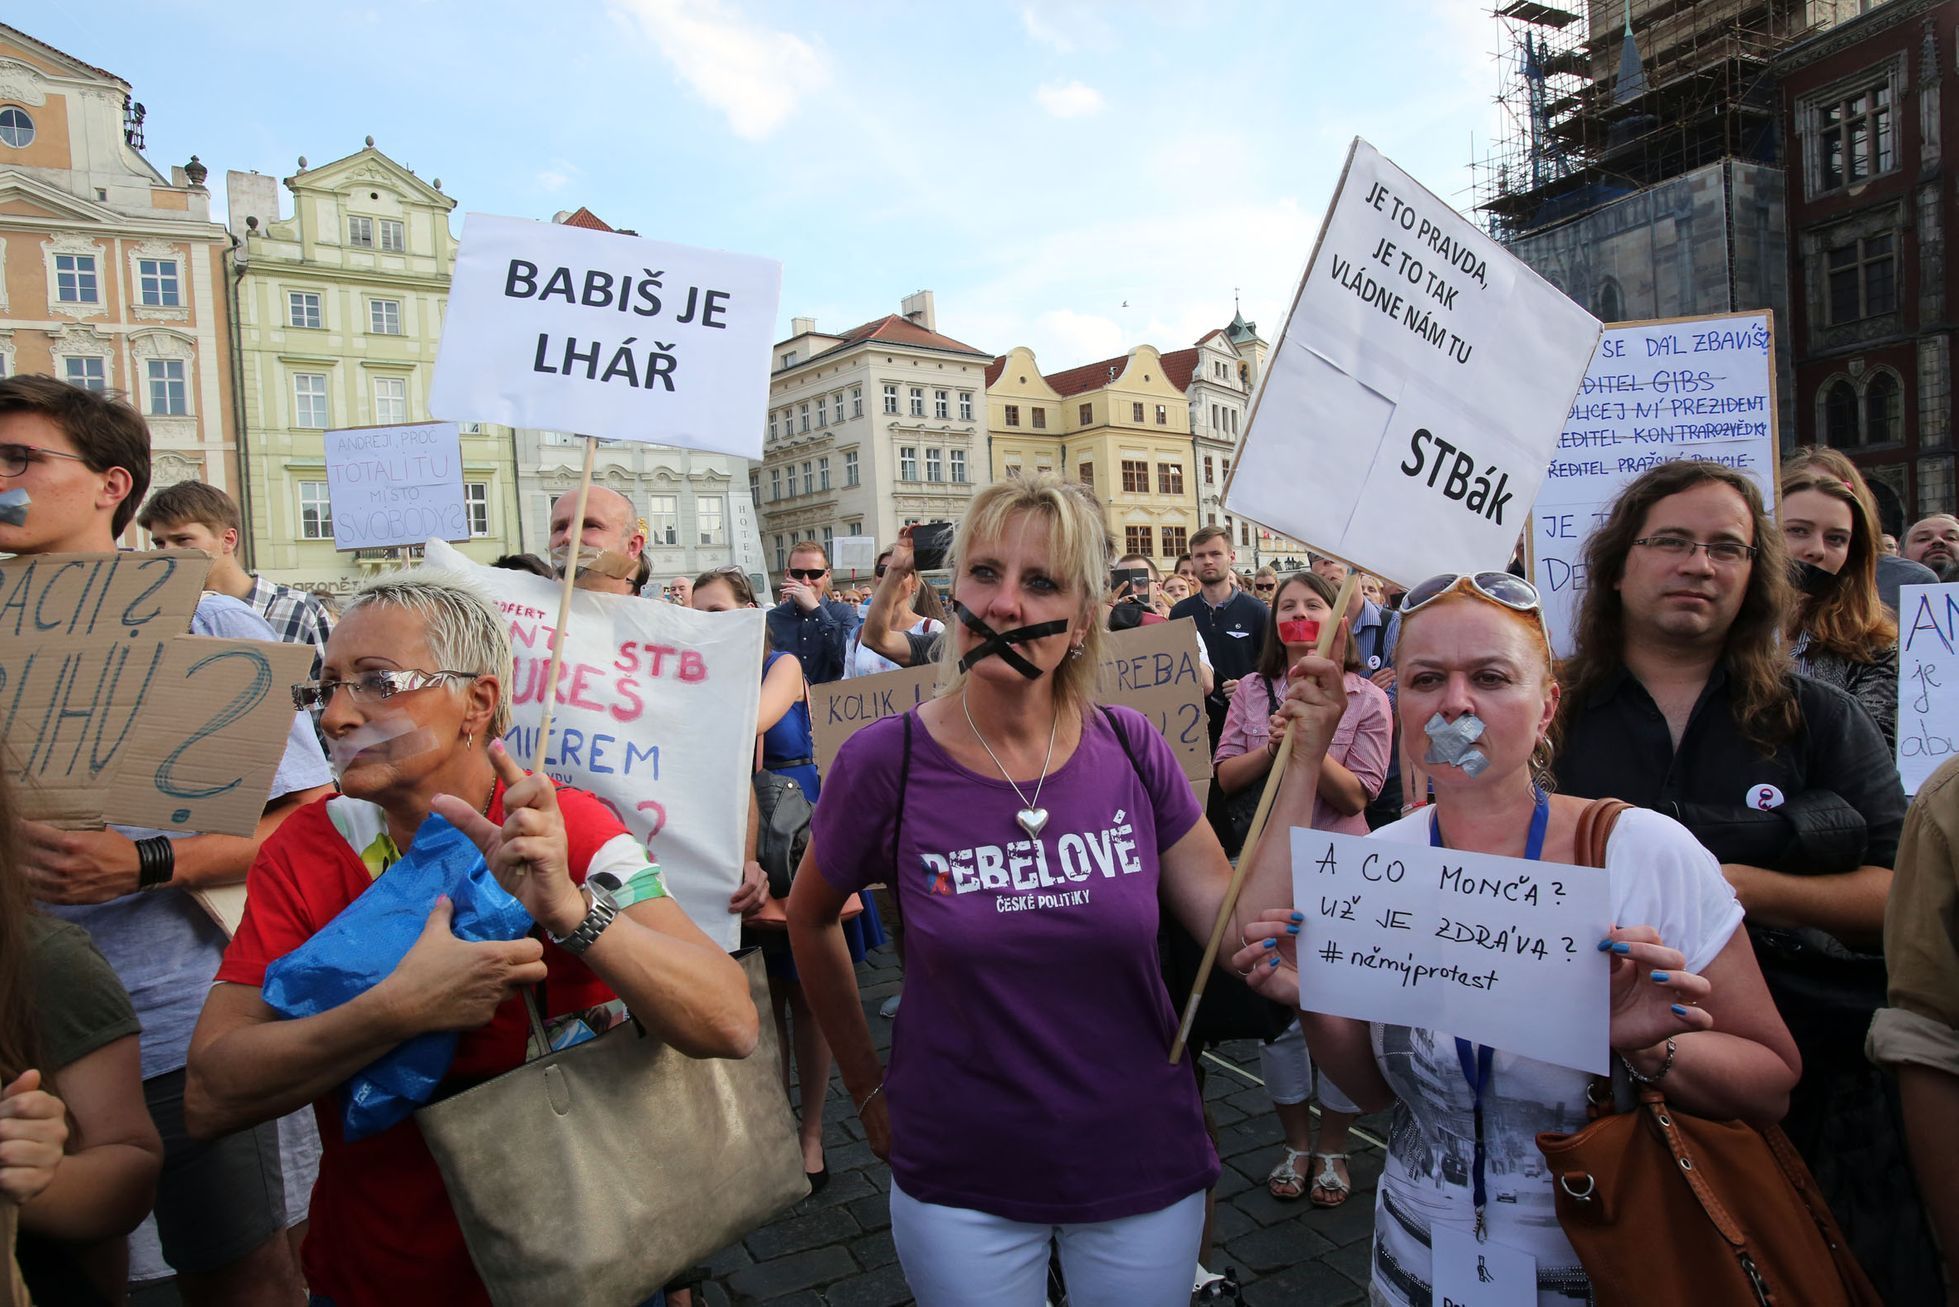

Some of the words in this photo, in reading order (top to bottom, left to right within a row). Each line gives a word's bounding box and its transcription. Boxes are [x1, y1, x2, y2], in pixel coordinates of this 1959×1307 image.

[1365, 181, 1389, 212] JE
[1391, 196, 1416, 231] TO
[1417, 218, 1488, 290] PRAVDA,
[1372, 237, 1397, 267] JE
[1398, 251, 1423, 284] TO
[1426, 270, 1459, 311] TAK
[504, 258, 665, 317] BABIŠ
[676, 285, 731, 329] JE
[1331, 253, 1404, 320] VLÁDNE
[1403, 304, 1447, 349] NÁM
[1448, 333, 1473, 365] TU
[533, 332, 678, 392] LHÁŘ
[1602, 339, 1626, 358] SE
[1646, 335, 1687, 357] DÁL
[1577, 374, 1644, 396] DITEL
[1652, 370, 1715, 394] GIBS
[1671, 395, 1767, 418] PREZIDENT
[1556, 429, 1622, 449] EDITEL
[331, 455, 448, 483] TOTALITU
[1400, 427, 1515, 526] STBák
[1547, 459, 1609, 478] ŘEDITEL
[370, 486, 420, 503] MÍSTO
[338, 503, 466, 543] SVOBODY?
[1542, 514, 1577, 538] JE
[1541, 557, 1588, 592] DE
[0, 553, 177, 638] ACII?
[614, 641, 709, 684] STB
[512, 655, 646, 723] UREŠ
[1911, 659, 1942, 714] je
[828, 689, 896, 725] KOLIK
[1315, 843, 1337, 875] A
[1362, 853, 1405, 882] CO
[996, 894, 1036, 913] ČESKÉ
[1037, 889, 1090, 909] POLITIKY
[1376, 909, 1413, 930] JE
